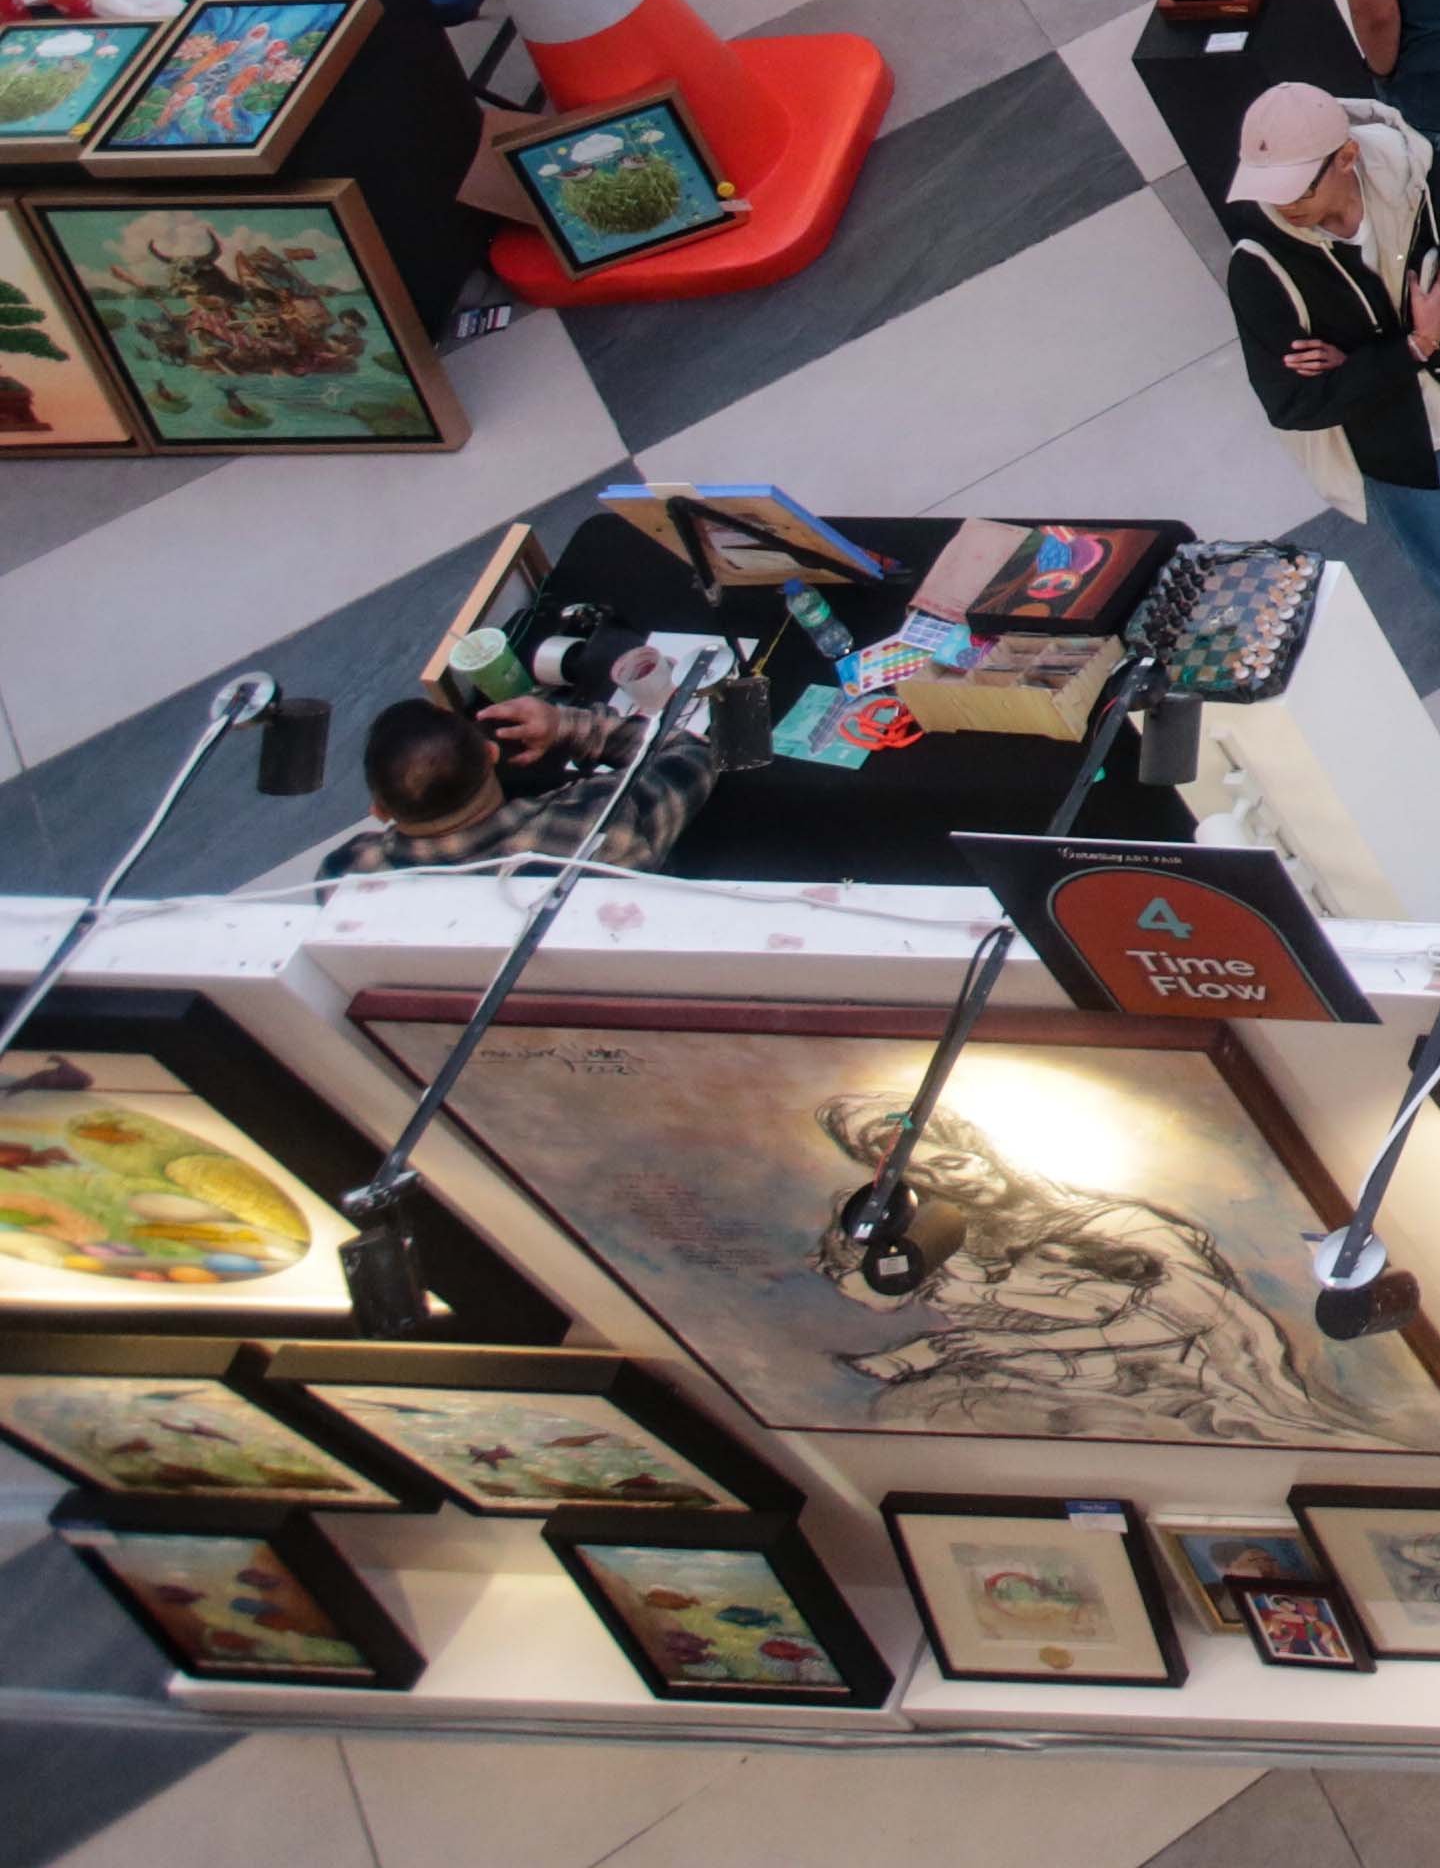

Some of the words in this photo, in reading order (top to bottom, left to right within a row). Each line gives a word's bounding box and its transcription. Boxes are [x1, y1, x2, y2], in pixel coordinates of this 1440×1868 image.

[1136, 896, 1194, 940] 4
[1125, 949, 1256, 978] Time
[1149, 975, 1267, 1002] Flow
